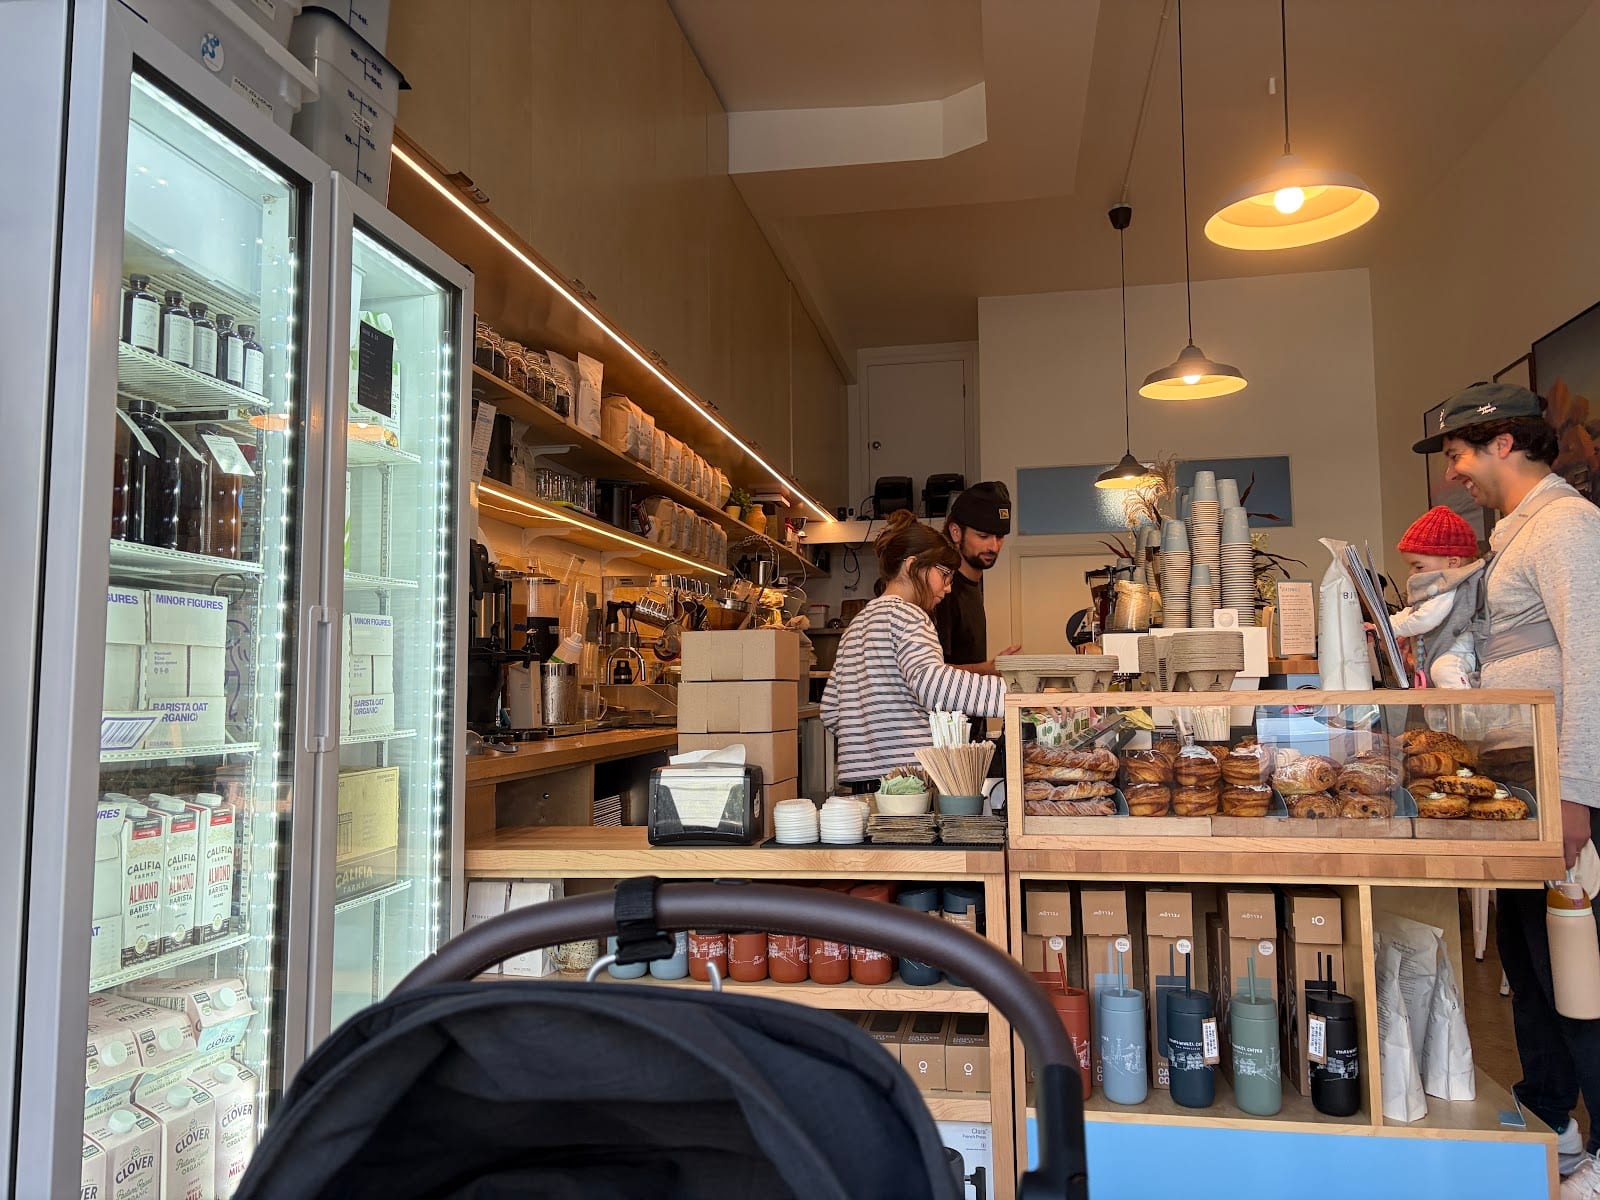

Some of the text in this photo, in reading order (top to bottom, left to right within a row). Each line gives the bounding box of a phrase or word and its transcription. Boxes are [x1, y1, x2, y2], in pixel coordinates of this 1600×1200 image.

[156, 594, 224, 610] MINOR FIGURES
[354, 617, 392, 627] MINOR FIGURES
[153, 702, 208, 712] BARISTA OAT
[354, 699, 376, 708] BARISTA
[162, 713, 198, 722] RGANIC)
[167, 853, 196, 867] CALIFIA
[206, 845, 233, 859] CALIFIA
[127, 860, 161, 876] CALIFIA
[208, 864, 231, 886] ALMOND
[168, 872, 195, 896] ALMOND
[336, 866, 373, 888] CALIFIA
[128, 881, 159, 906] ALMOND
[208, 886, 229, 896] BARISTA
[129, 903, 156, 916] BARISTA
[206, 1035, 235, 1051] CLOVER
[221, 1104, 253, 1128] CLOVER
[175, 1128, 210, 1154] CLOVER
[115, 1155, 154, 1185] CLOVER
